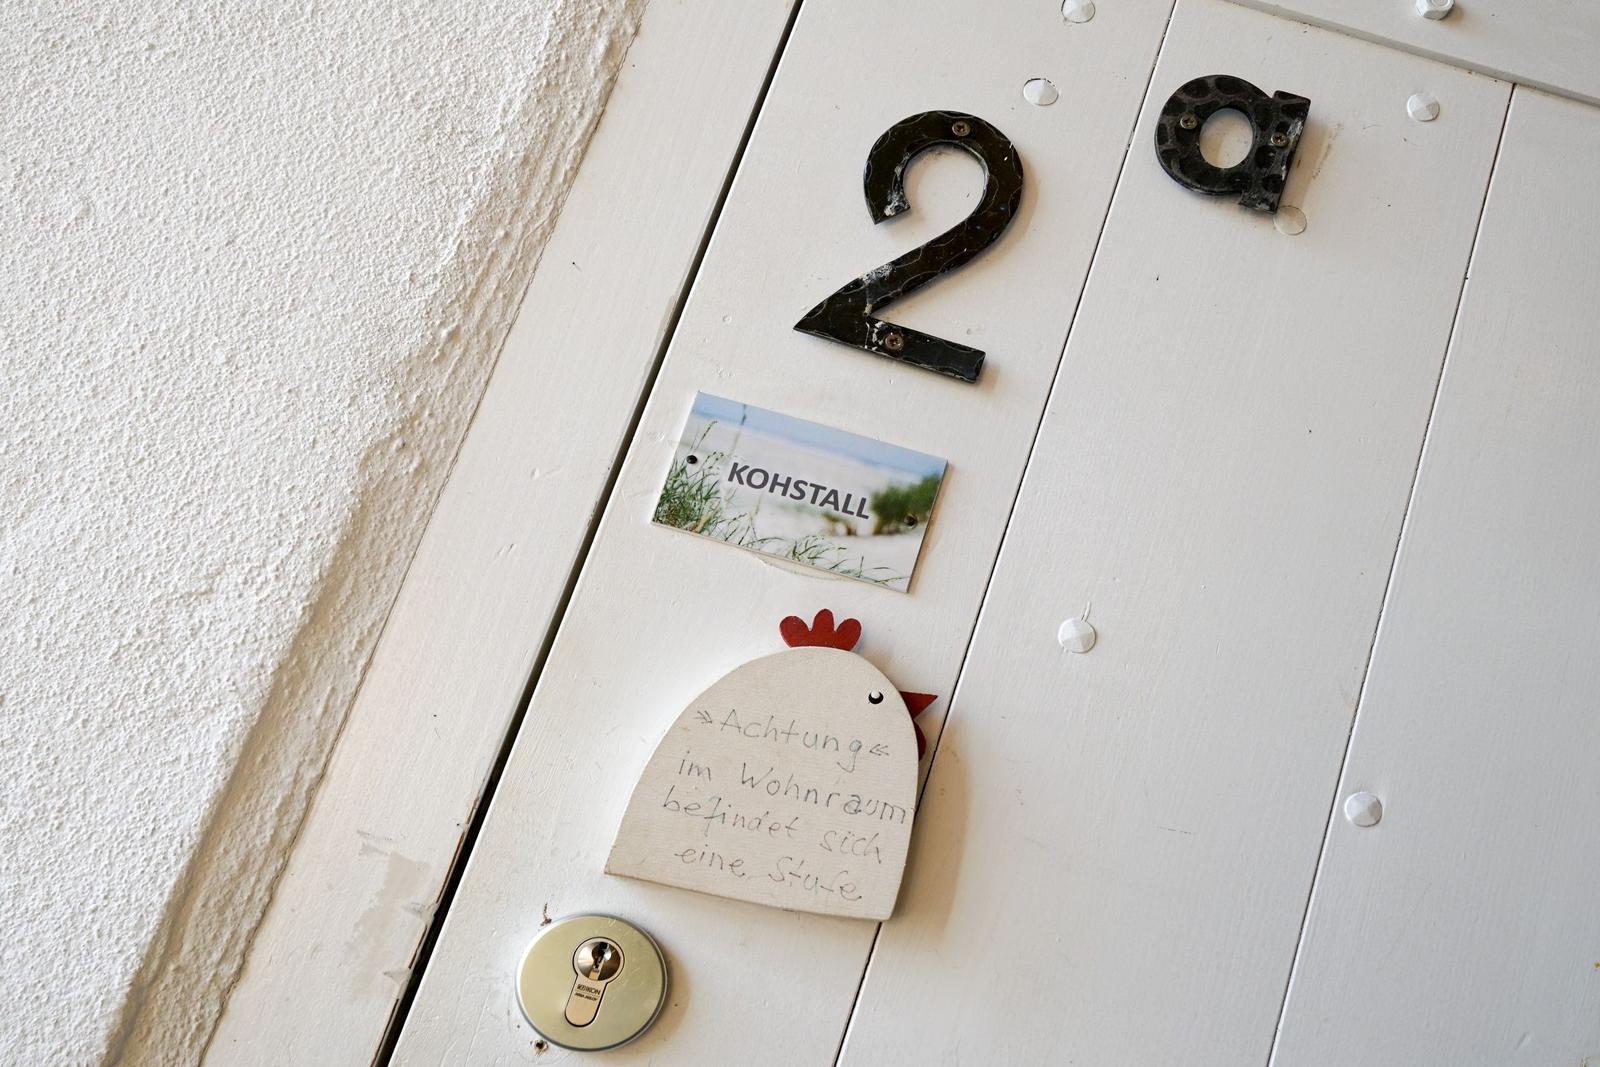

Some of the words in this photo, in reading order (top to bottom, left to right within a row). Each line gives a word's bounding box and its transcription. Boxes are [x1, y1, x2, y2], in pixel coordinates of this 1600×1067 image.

[794, 110, 1024, 384] 2
[1155, 74, 1311, 215] a
[727, 461, 870, 520] KOHSTALL
[663, 785, 799, 837] befindet
[820, 830, 882, 865] sich
[678, 750, 712, 782] im
[740, 762, 907, 825] Wohnraum
[674, 846, 746, 877] eine
[768, 856, 863, 902] Stufe
